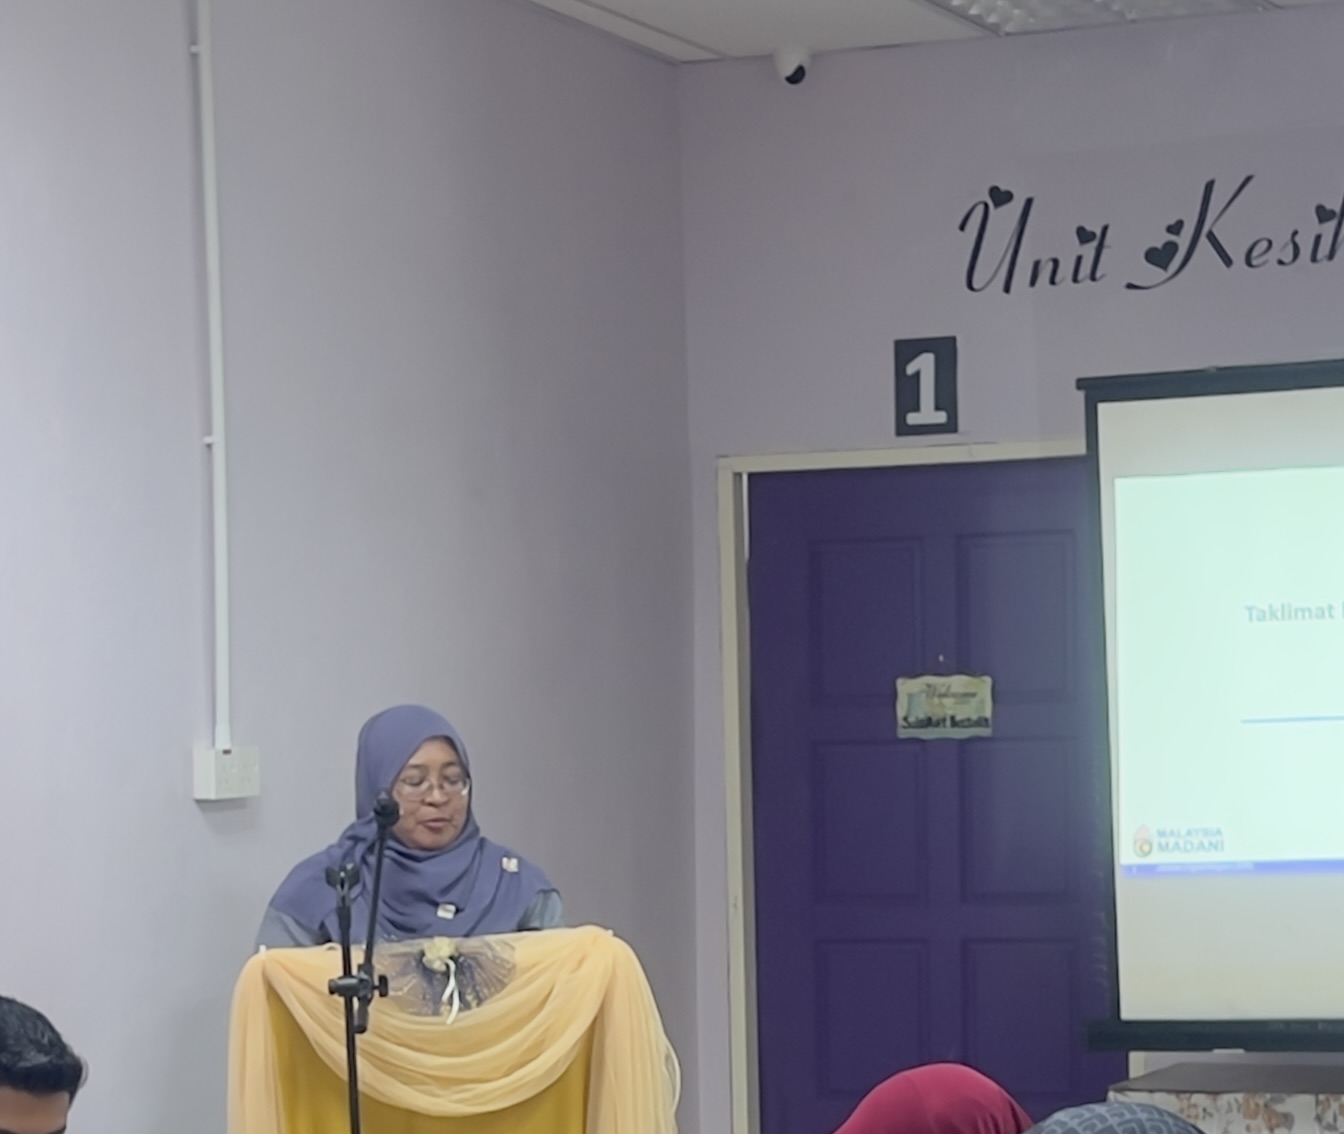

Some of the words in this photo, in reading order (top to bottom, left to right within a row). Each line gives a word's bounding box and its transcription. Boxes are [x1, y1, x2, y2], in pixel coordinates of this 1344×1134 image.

[958, 190, 1113, 295] Unit
[905, 352, 948, 426] 1
[1243, 602, 1335, 623] Taklimat
[1156, 826, 1224, 839] MALAYSIA
[1156, 839, 1225, 853] MADANI
